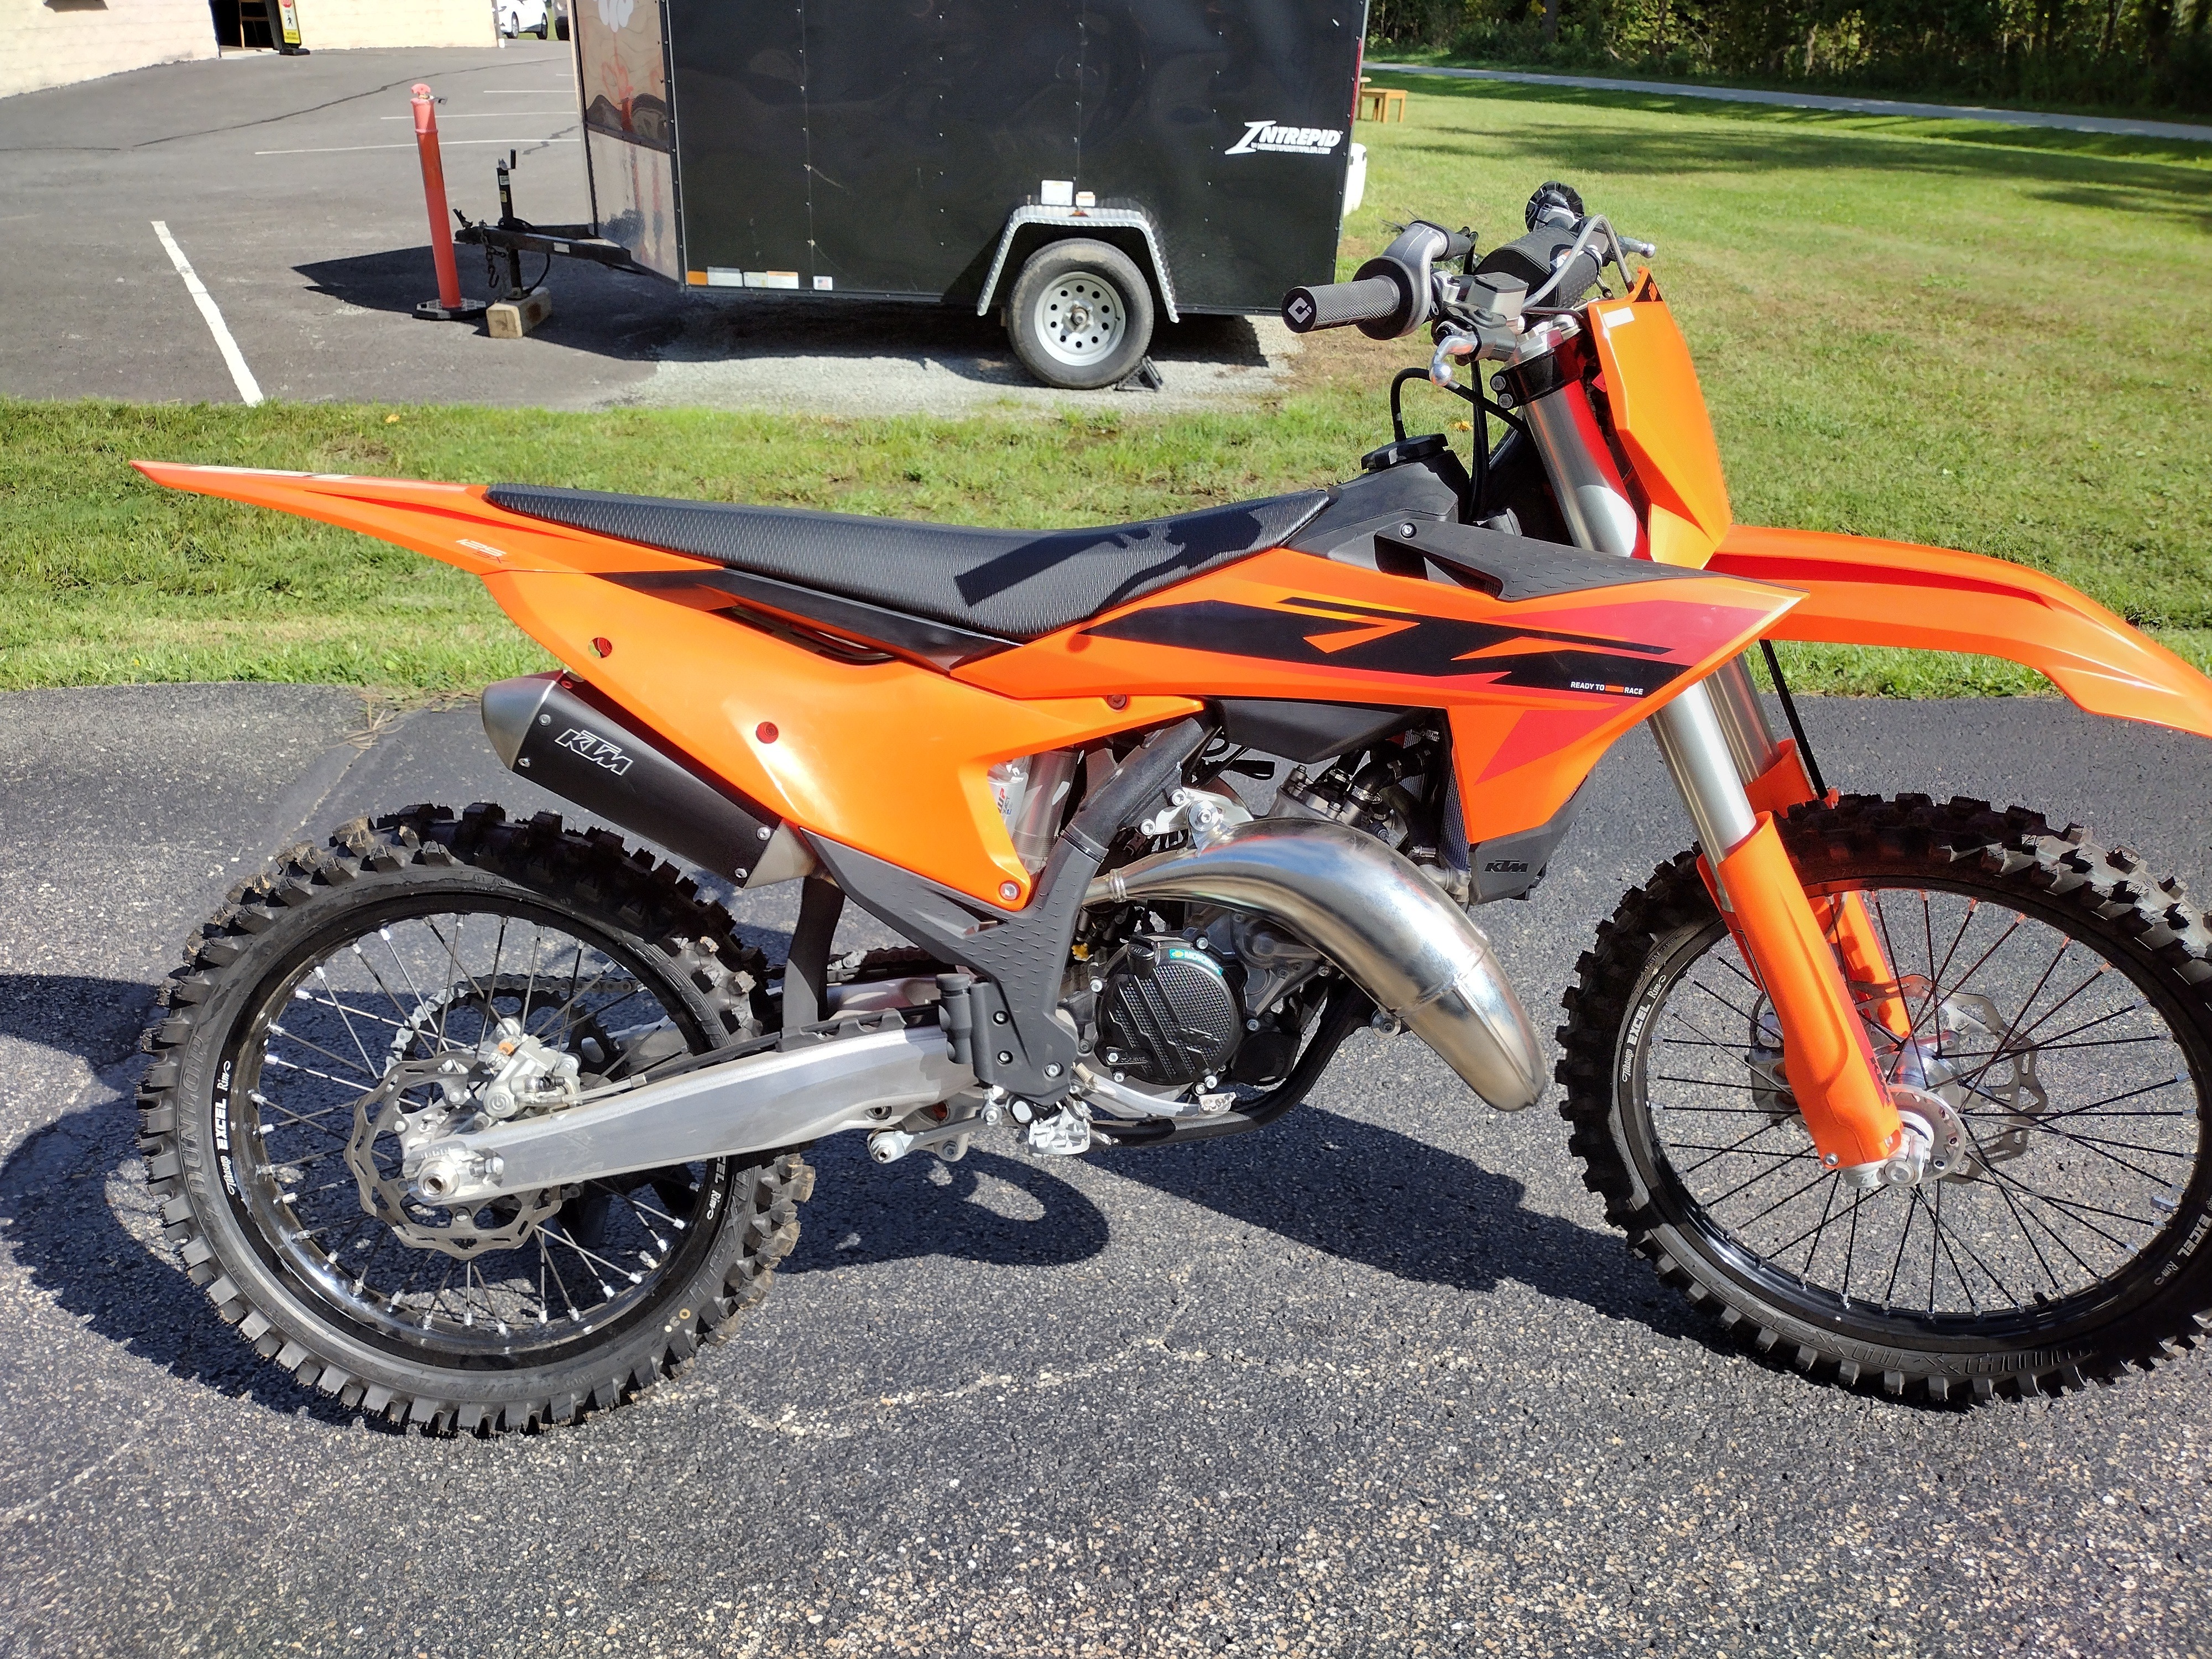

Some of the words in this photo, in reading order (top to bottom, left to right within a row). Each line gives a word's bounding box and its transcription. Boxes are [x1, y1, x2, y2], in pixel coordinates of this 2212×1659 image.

[1224, 120, 1341, 155] INTREPID
[456, 539, 507, 557] 125
[1571, 681, 1595, 690] READY
[1624, 687, 1644, 695] RACE
[554, 728, 634, 776] KTM
[1484, 859, 1529, 874] KTM
[1626, 1004, 1651, 1046] EXCEL
[1646, 974, 1666, 999] Rim
[217, 1060, 231, 1092] Rim
[215, 1098, 229, 1151] EXCEL
[707, 1190, 722, 1220] Rim
[2177, 1213, 2211, 1257] EXCEL
[2153, 1260, 2180, 1286] Rim
